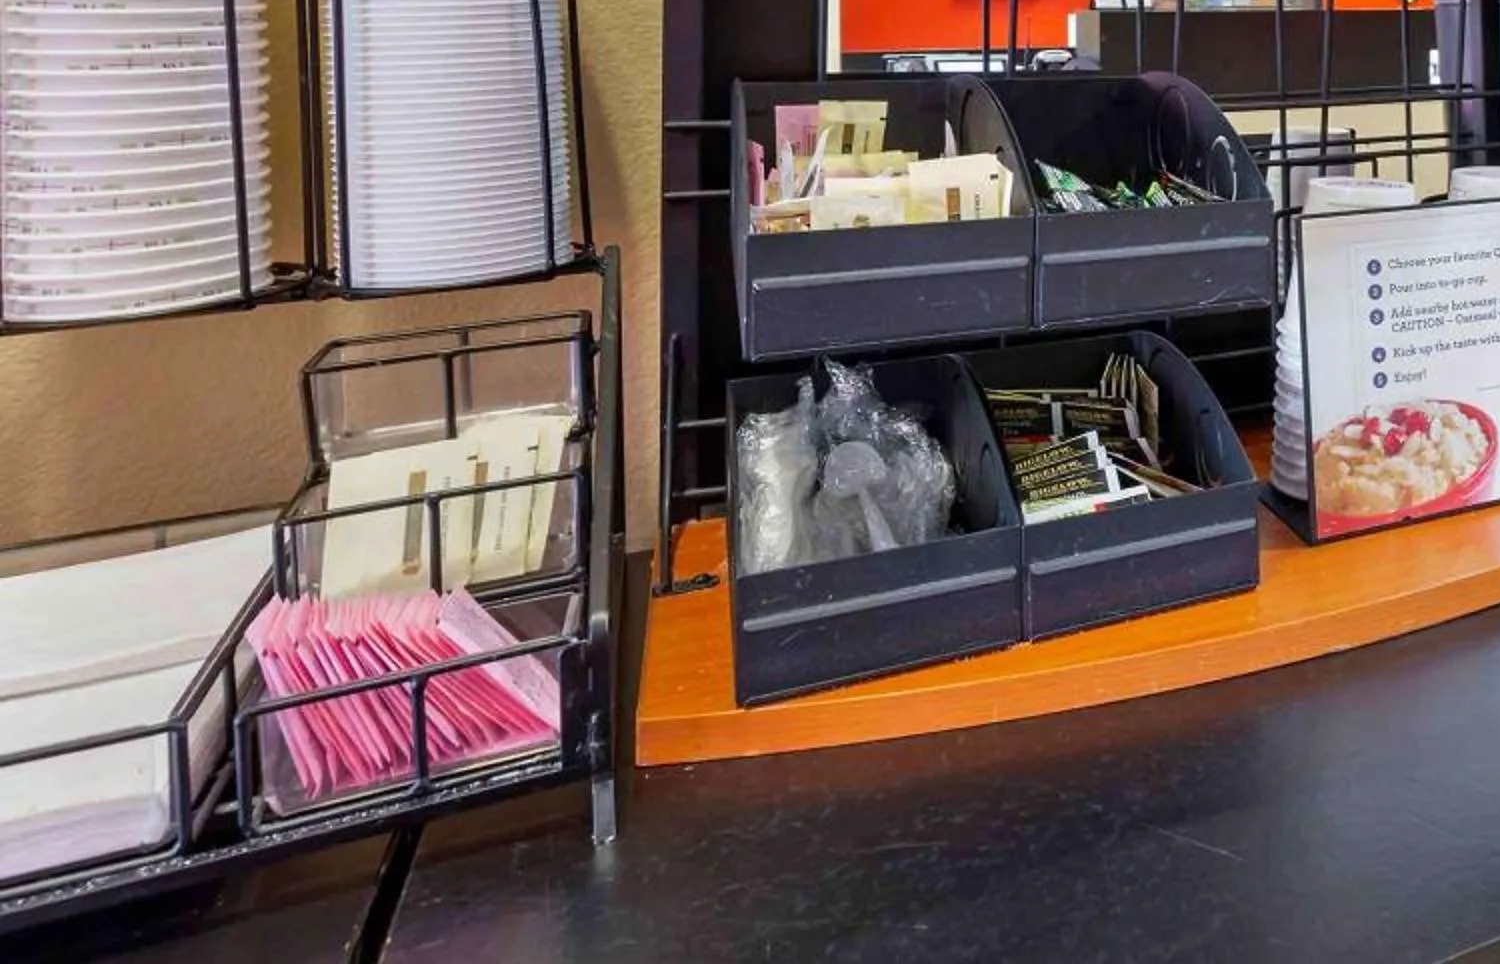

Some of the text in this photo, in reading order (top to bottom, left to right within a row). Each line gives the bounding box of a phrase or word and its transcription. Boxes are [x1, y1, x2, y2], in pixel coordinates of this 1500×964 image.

[1427, 255, 1452, 267] your
[1453, 248, 1492, 263] favorite
[1389, 283, 1413, 294] Pour
[1415, 280, 1437, 291] into
[1391, 305, 1412, 319] Add
[1392, 316, 1445, 333] CAUTION
[1455, 307, 1497, 324] Oatmeal
[1393, 344, 1417, 358] Kick
[1419, 345, 1433, 356] up
[1435, 339, 1451, 352] the
[1453, 337, 1478, 349] taste
[1015, 447, 1073, 471] BIGELOW
